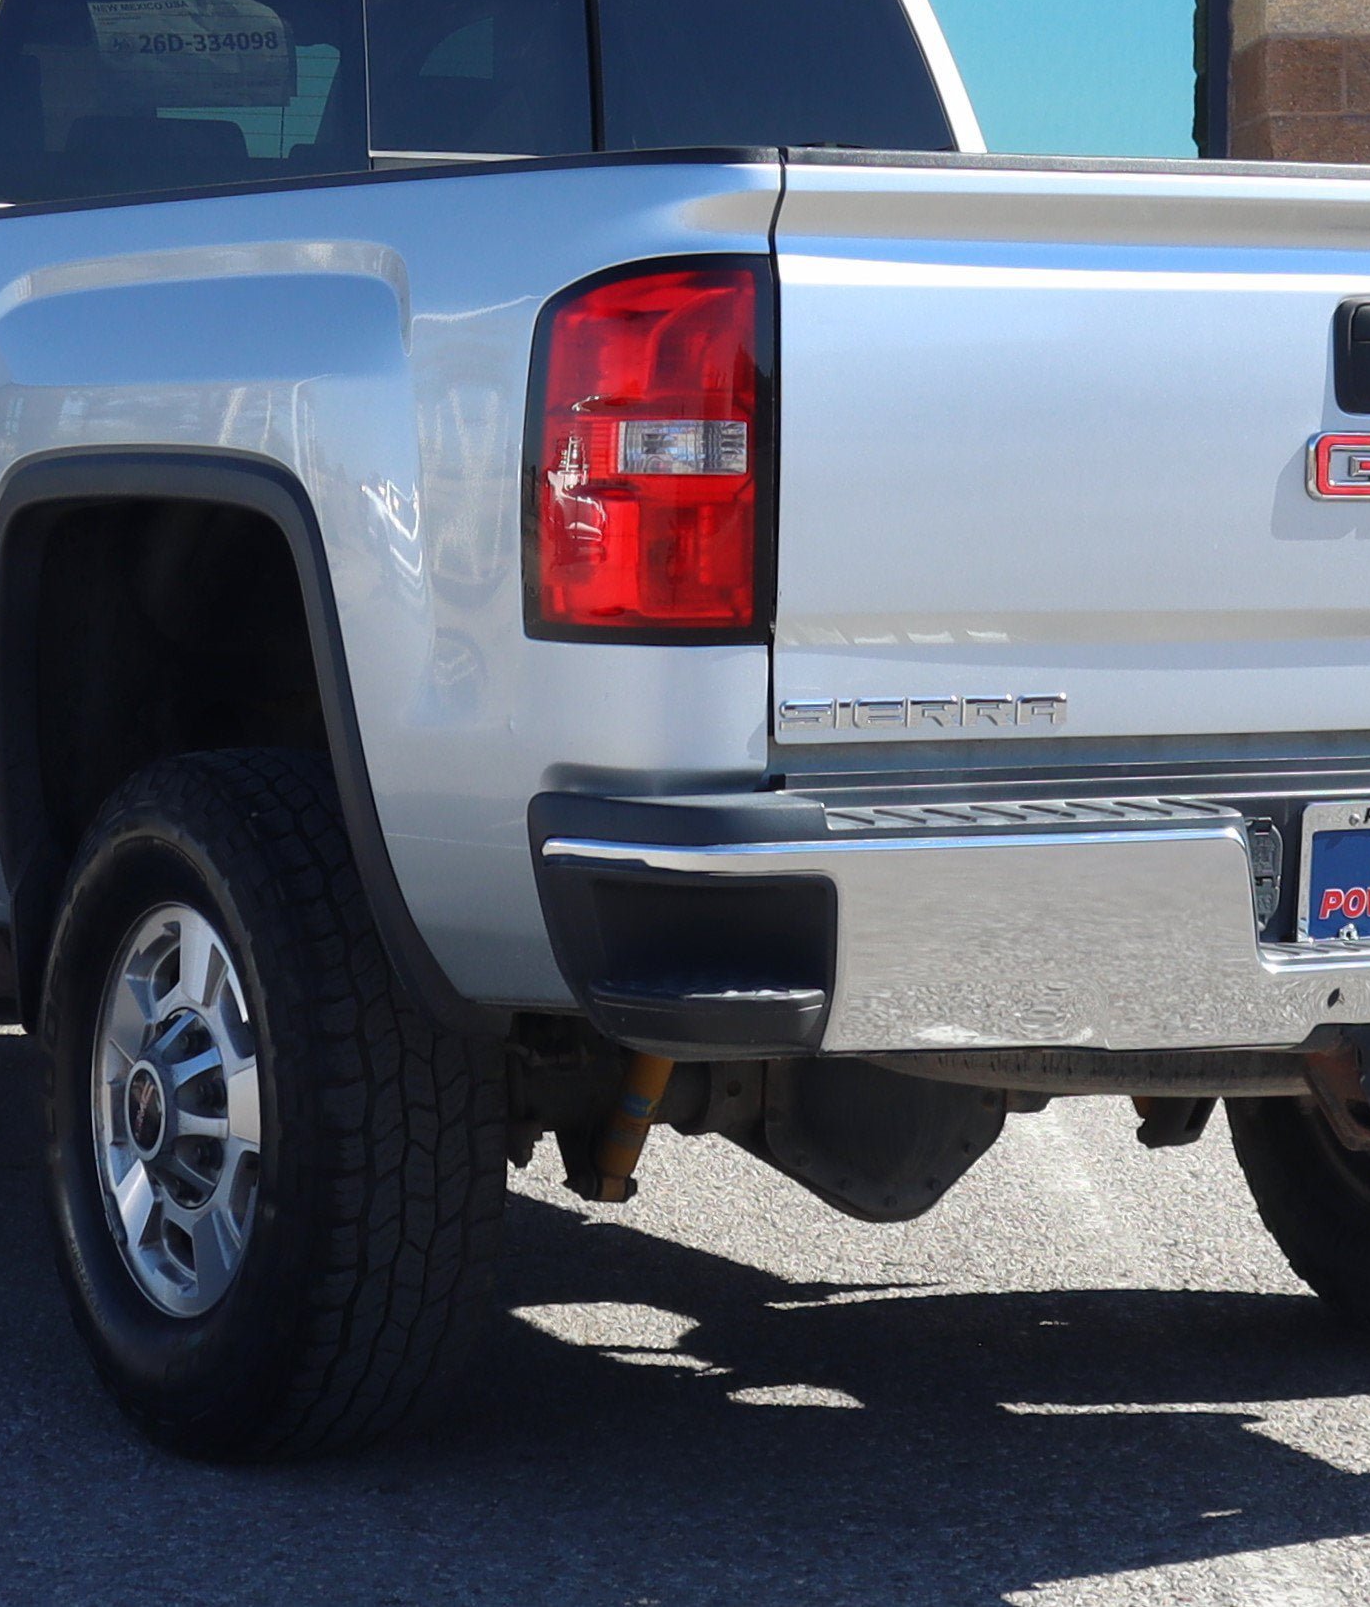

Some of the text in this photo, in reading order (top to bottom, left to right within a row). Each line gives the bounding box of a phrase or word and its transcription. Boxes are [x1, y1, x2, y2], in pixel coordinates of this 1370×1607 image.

[92, 0, 189, 13] NEW MEXICO USA
[138, 31, 279, 55] 26D-334098
[779, 691, 1067, 731] SIERRA
